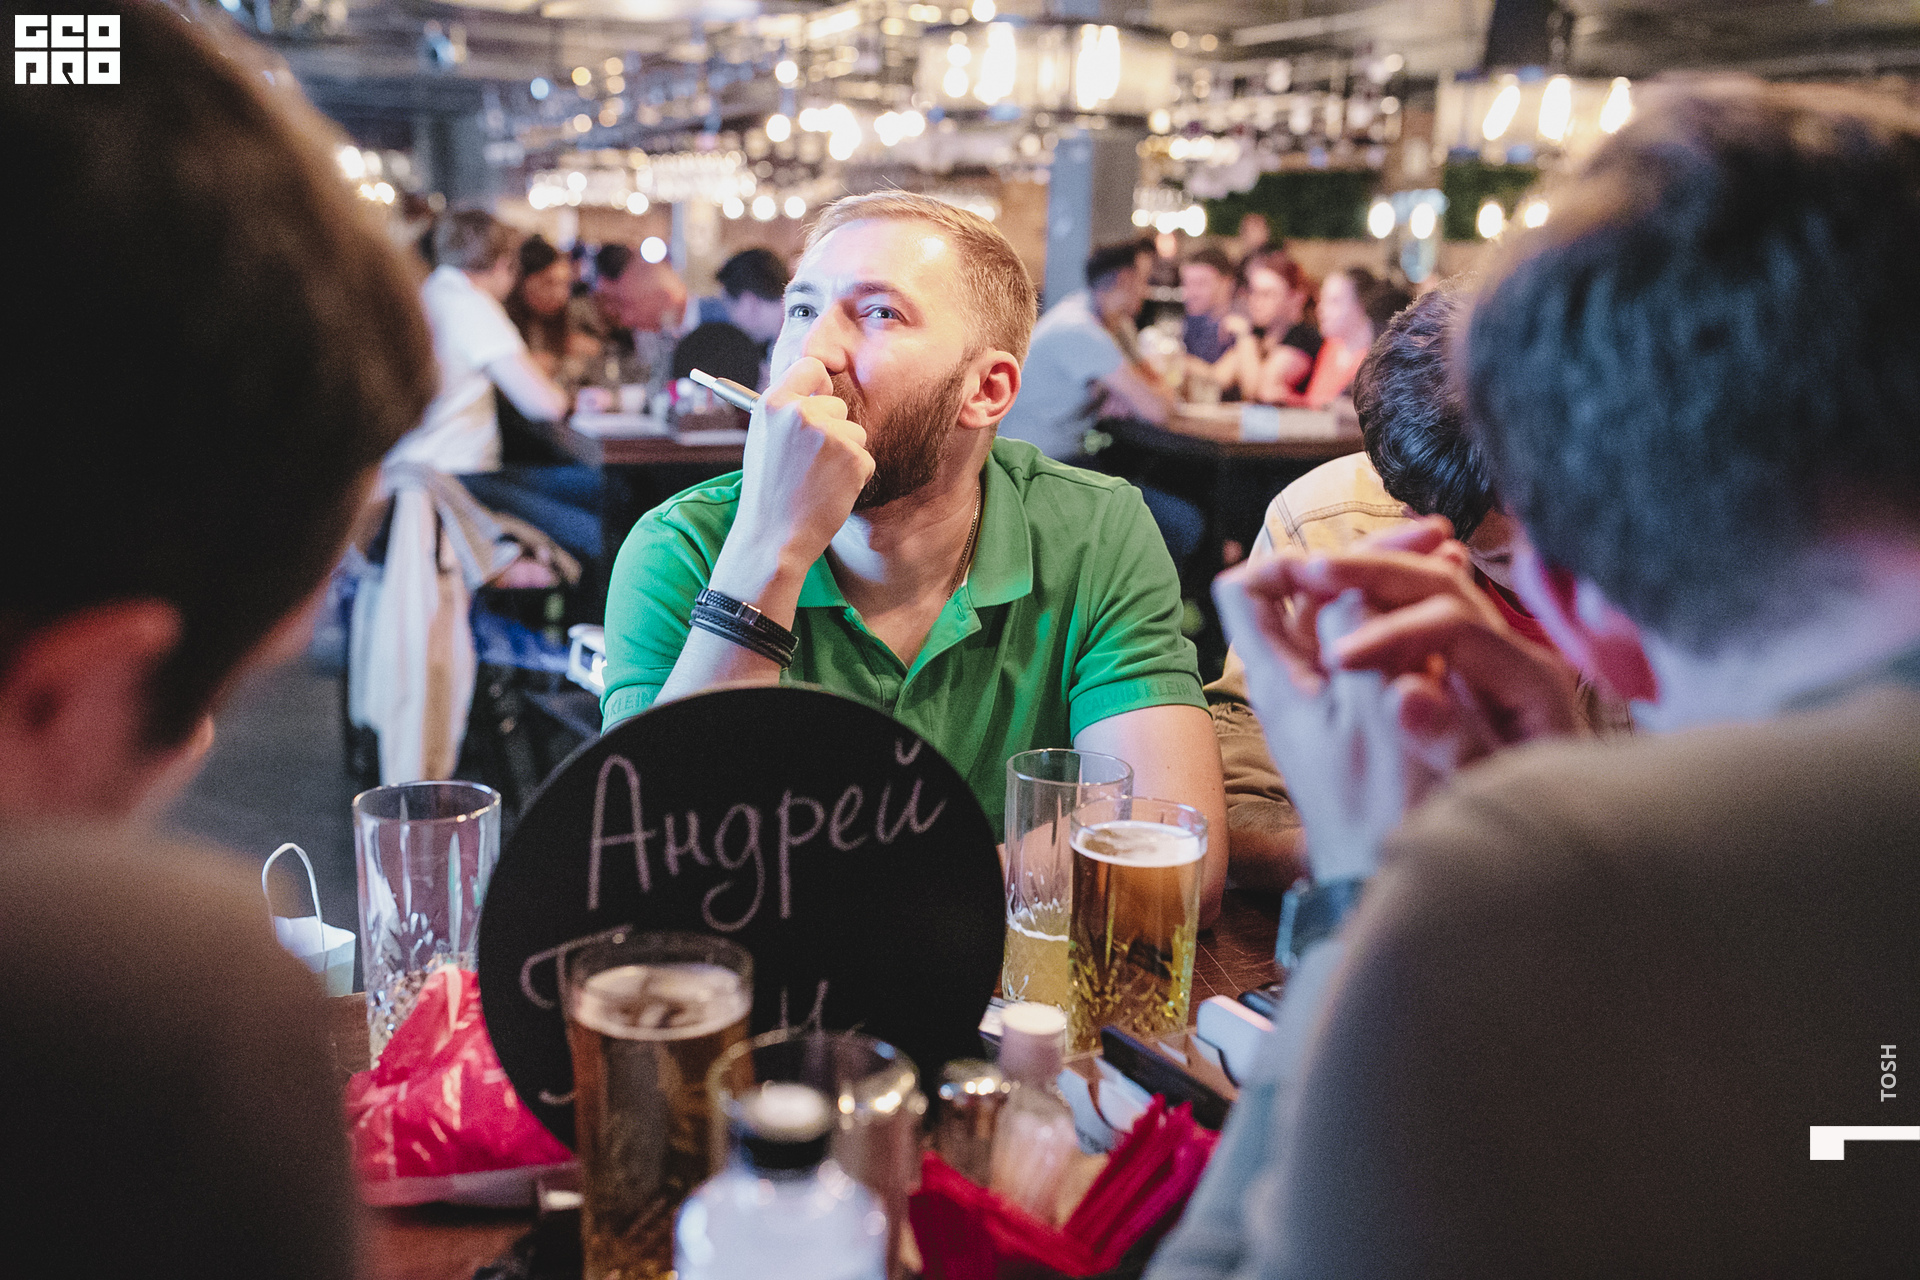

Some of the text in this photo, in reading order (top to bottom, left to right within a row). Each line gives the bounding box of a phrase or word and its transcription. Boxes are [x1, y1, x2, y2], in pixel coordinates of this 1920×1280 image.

[1082, 682, 1141, 715] CALVIN
[1143, 680, 1193, 699] KLEIN
[587, 738, 948, 932] Андрей
